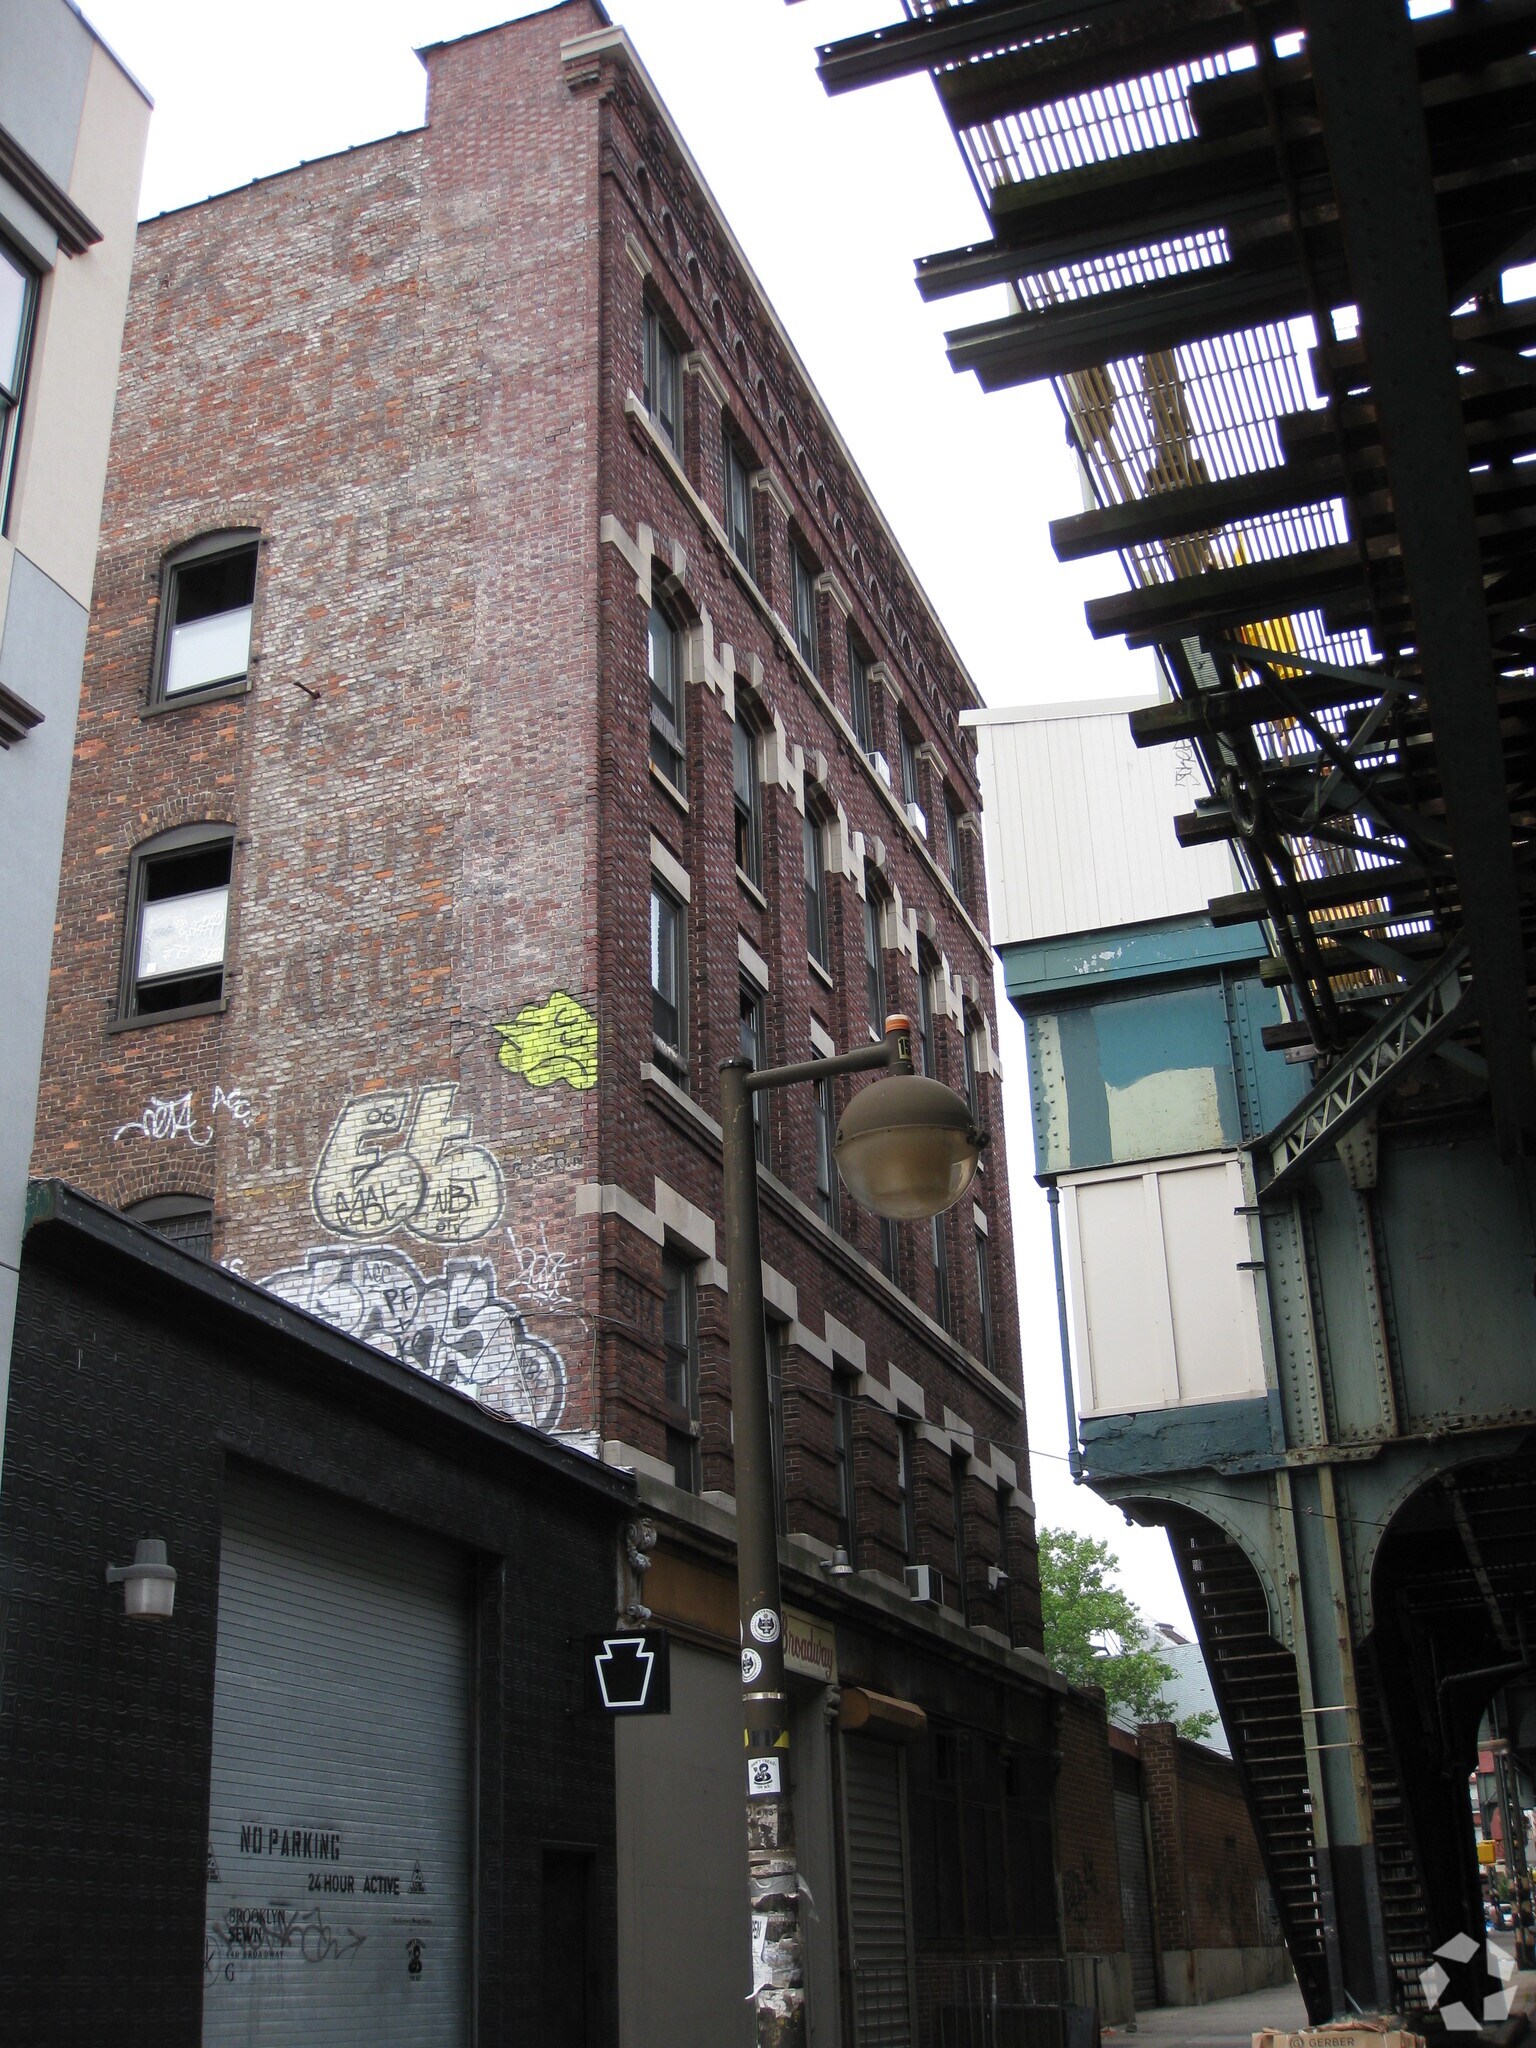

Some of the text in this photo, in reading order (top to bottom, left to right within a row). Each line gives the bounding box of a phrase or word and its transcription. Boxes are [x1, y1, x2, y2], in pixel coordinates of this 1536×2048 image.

[240, 1824, 341, 1860] NO PARKING
[308, 1872, 321, 1892] 24
[324, 1873, 355, 1893] HOUR
[363, 1875, 400, 1896] ACTIVE
[229, 1907, 286, 1925] BROOKLYN
[228, 1925, 263, 1943] SEWN
[1308, 2037, 1356, 2048] GERBER
